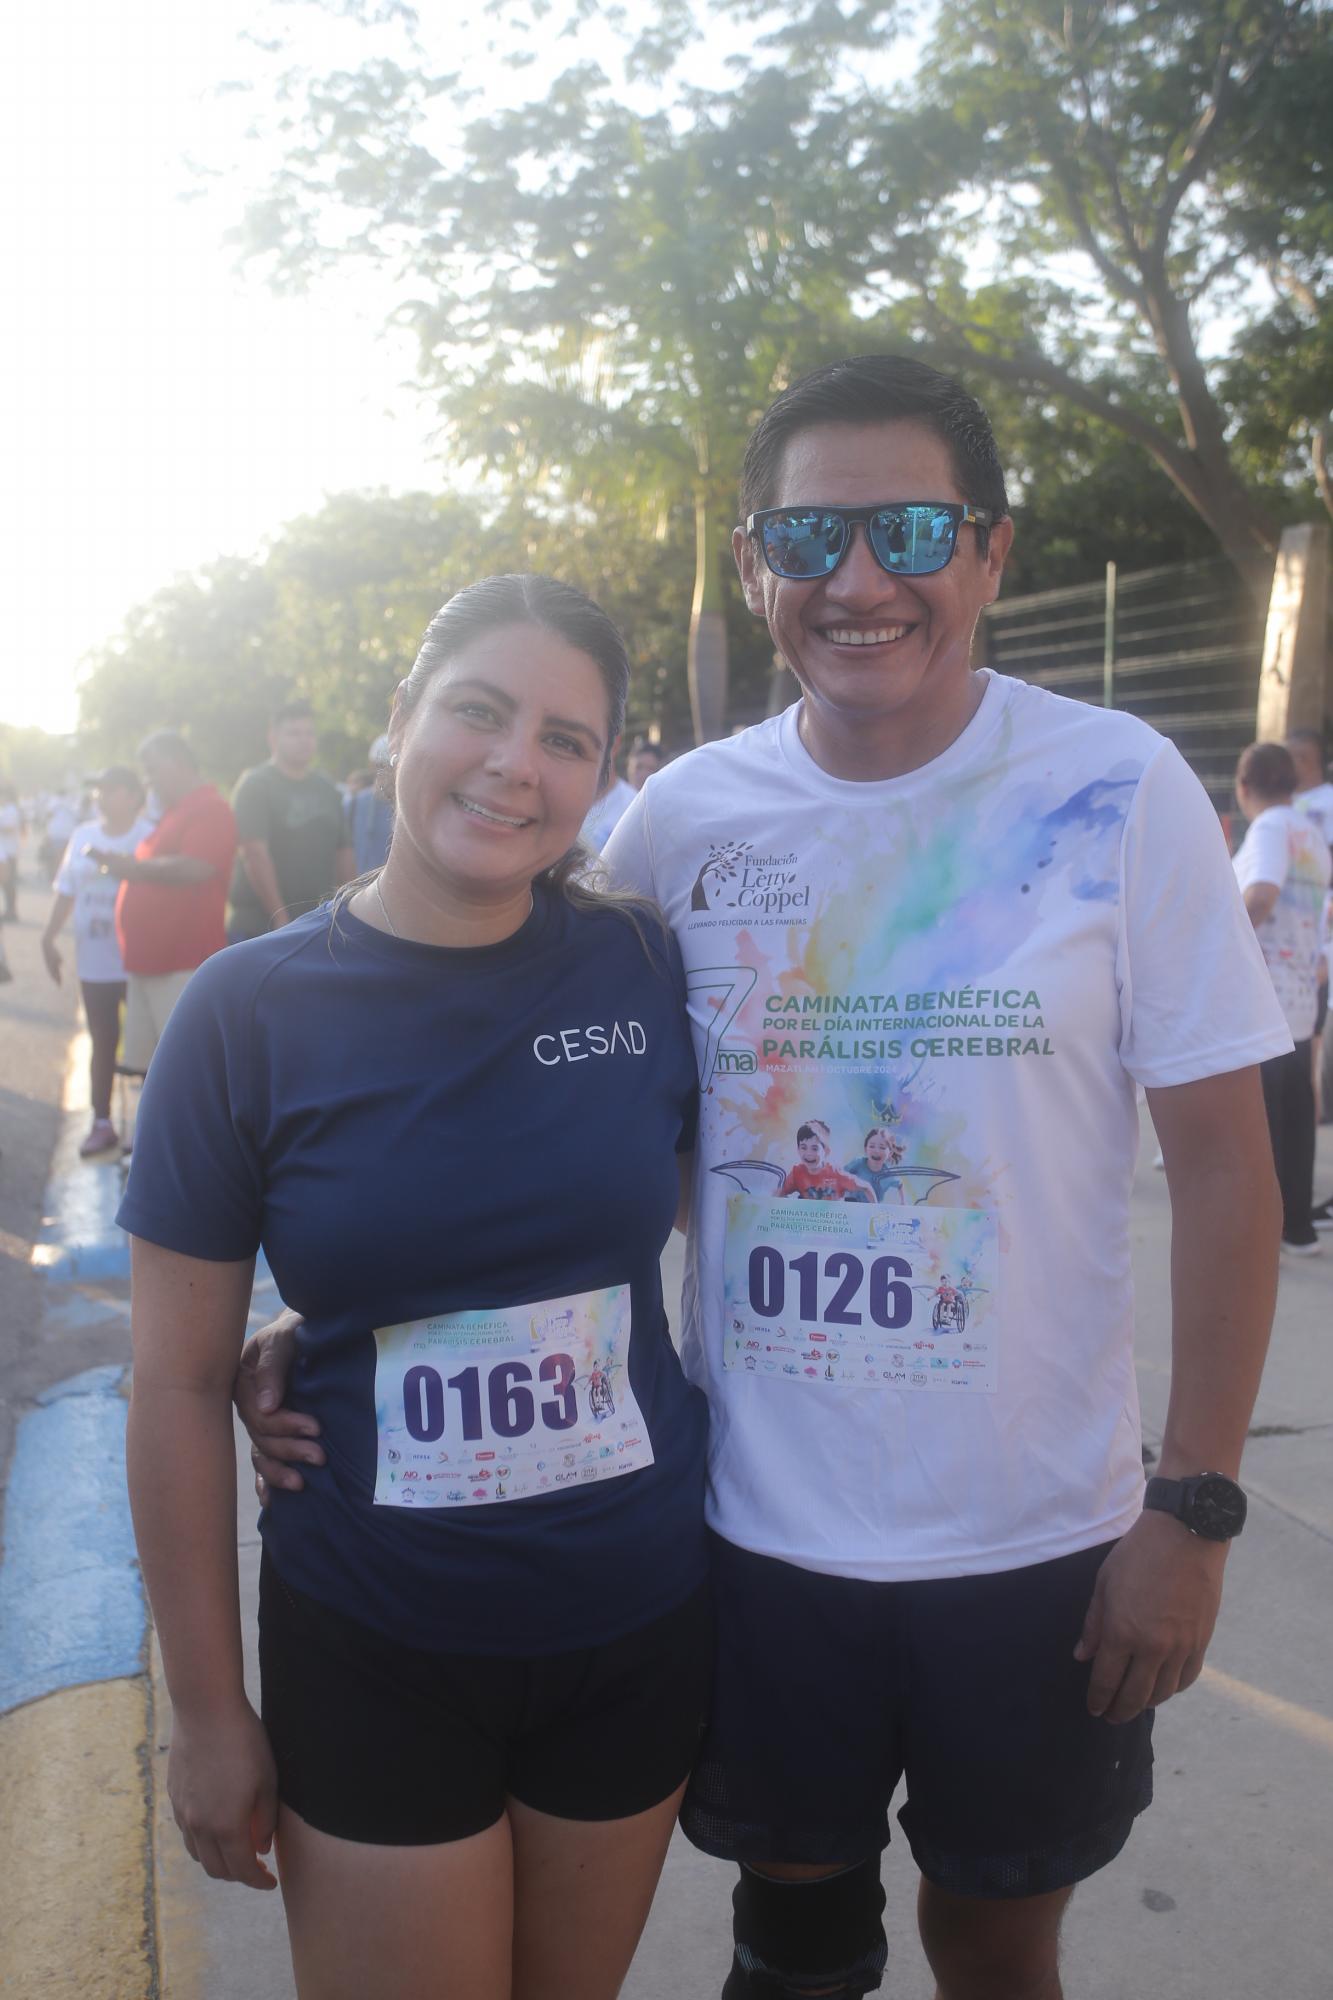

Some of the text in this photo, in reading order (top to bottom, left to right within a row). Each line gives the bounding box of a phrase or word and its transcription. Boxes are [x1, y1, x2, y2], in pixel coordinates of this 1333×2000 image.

[745, 853, 798, 867] Fundación
[741, 868, 791, 889] Letty
[738, 886, 810, 913] Coppel
[688, 920, 718, 930] LLEVANDO
[719, 919, 753, 927] FELICIDAD
[775, 918, 808, 926] FAMILIAS
[765, 984, 1042, 1014] CAMINATA BENÉFICA
[763, 1014, 1045, 1032] POR EL DÍA INTERNACIONAL DE LA
[533, 1021, 647, 1066] CESAD
[763, 1036, 1056, 1059] PARÁLISIS CEREBRAL
[770, 1208, 808, 1217] CAMINATA
[748, 1245, 913, 1329] 0126
[402, 1353, 578, 1443] 0163
